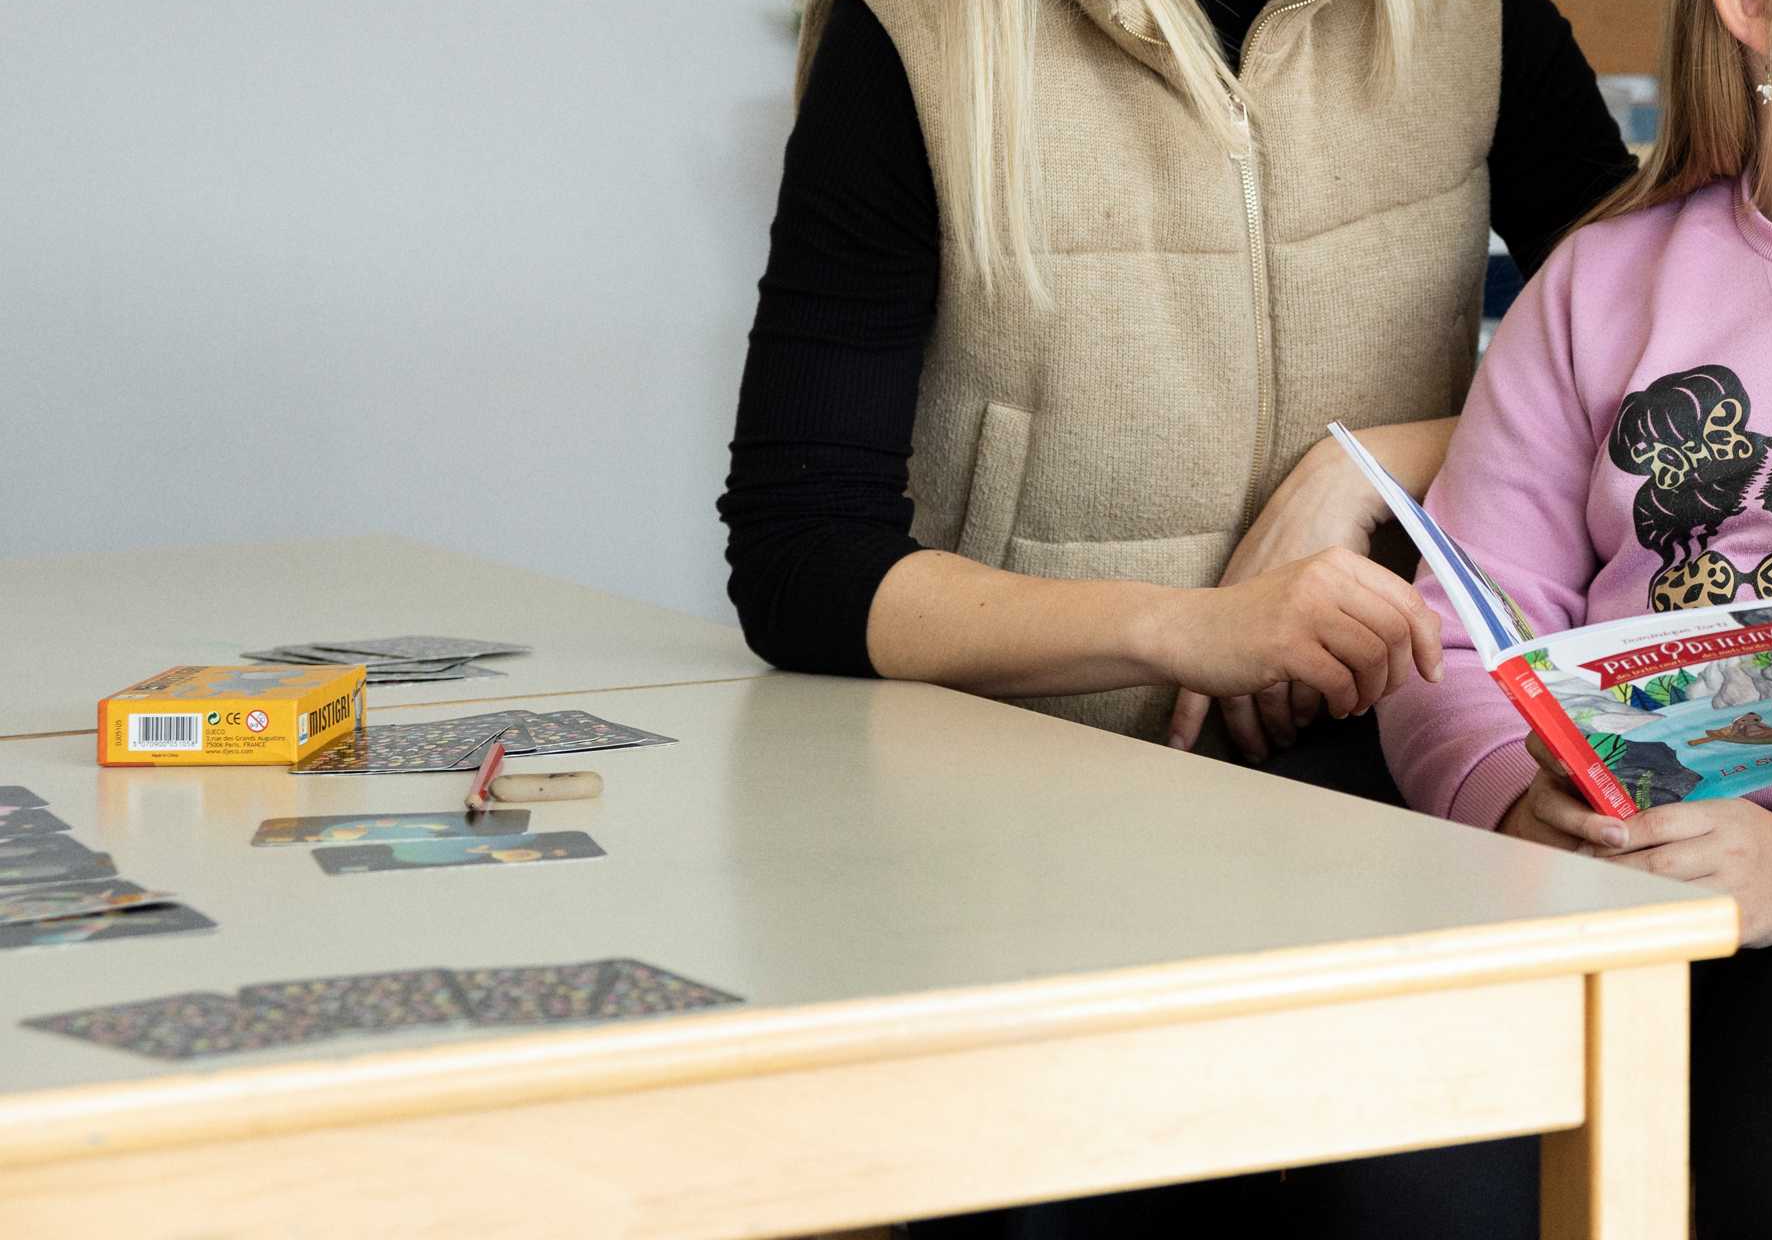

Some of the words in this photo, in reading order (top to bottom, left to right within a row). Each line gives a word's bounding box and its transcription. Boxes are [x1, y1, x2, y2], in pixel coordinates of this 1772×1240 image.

[1602, 651, 1659, 675] PETIT
[309, 693, 350, 738] MISTIGRI
[1719, 764, 1748, 777] La
